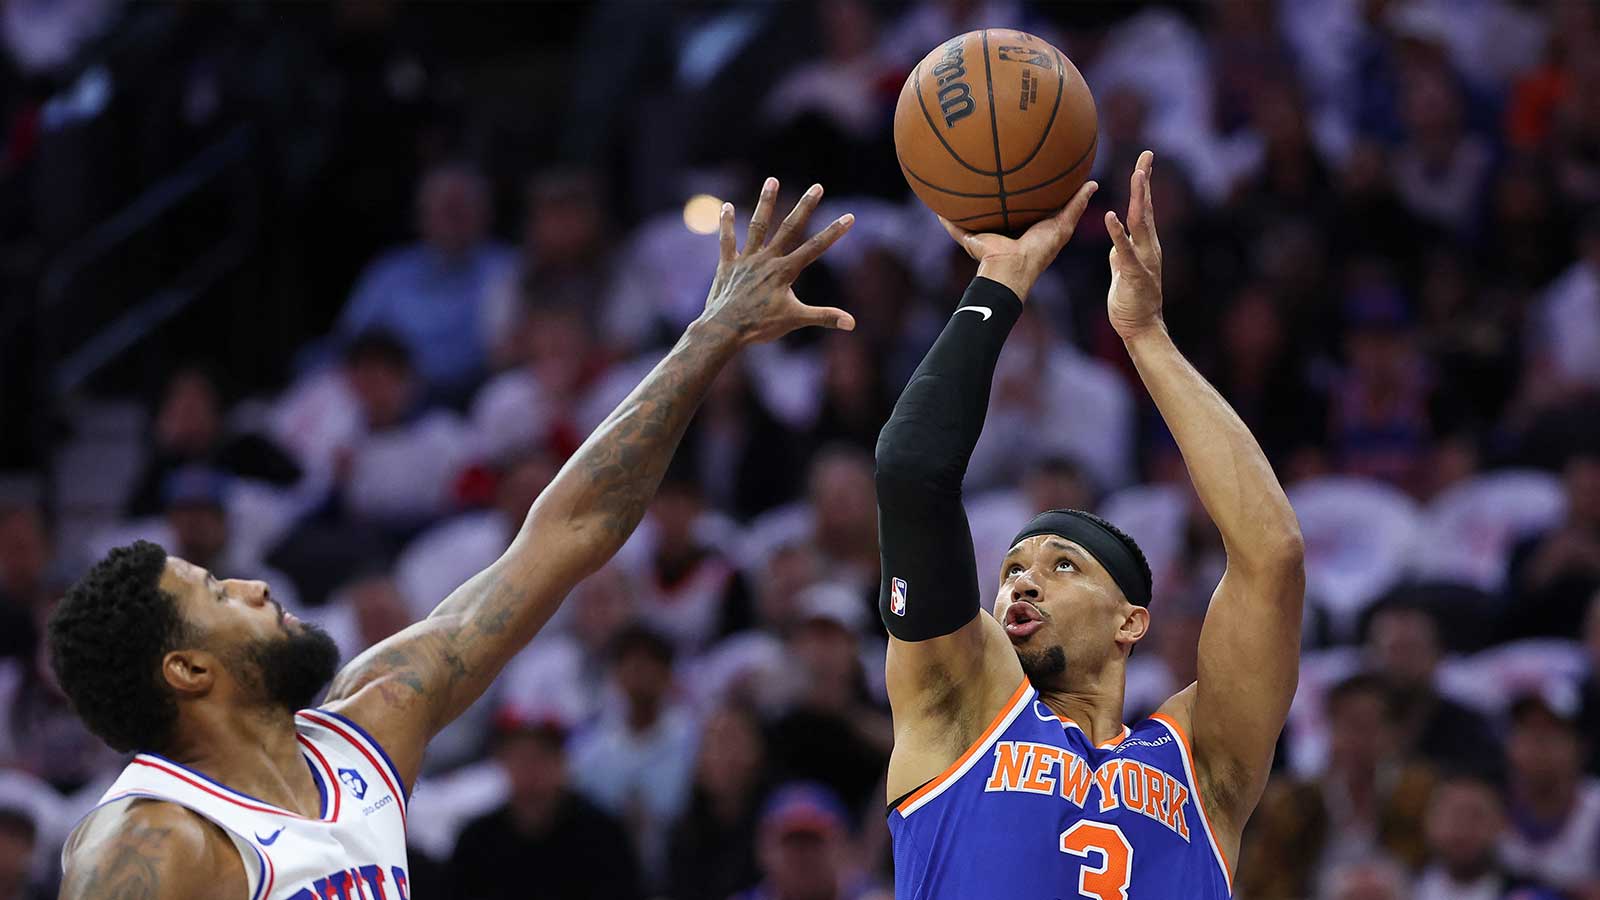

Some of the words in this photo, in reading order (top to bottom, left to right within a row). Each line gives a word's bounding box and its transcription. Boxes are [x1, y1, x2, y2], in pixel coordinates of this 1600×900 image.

[984, 741, 1094, 809] NEW
[1093, 758, 1191, 844] YORK
[1060, 818, 1134, 900] 3
